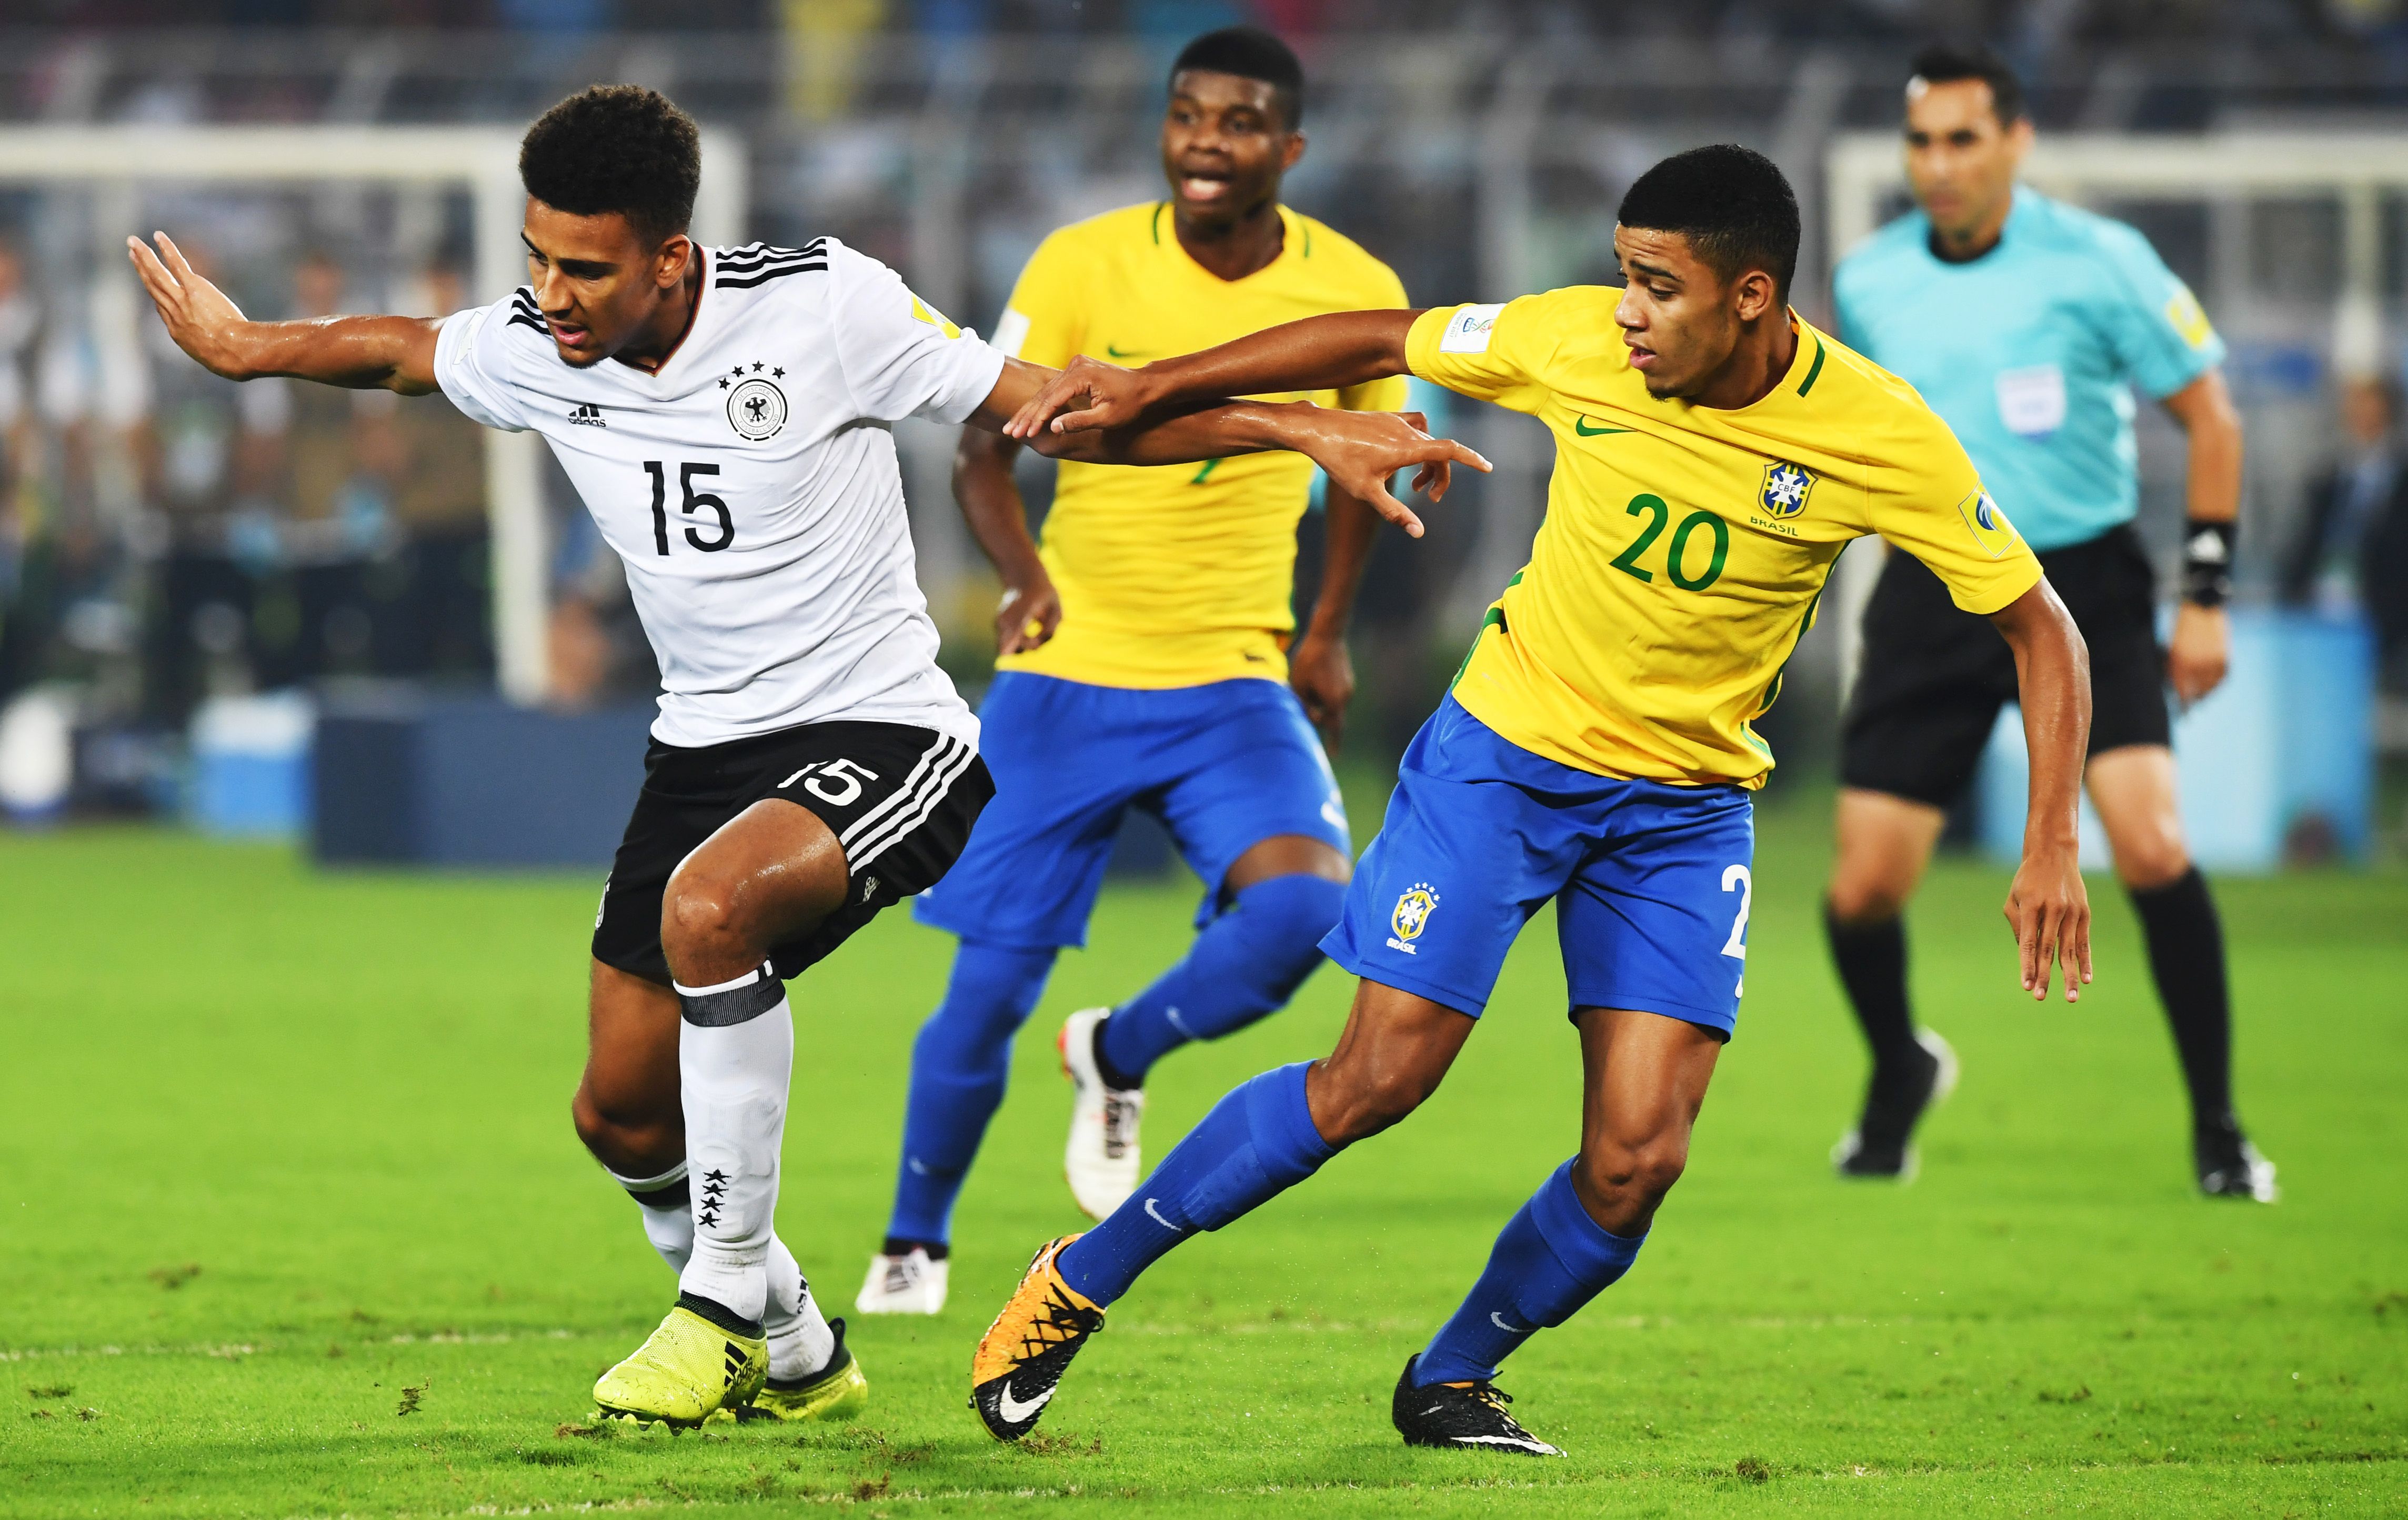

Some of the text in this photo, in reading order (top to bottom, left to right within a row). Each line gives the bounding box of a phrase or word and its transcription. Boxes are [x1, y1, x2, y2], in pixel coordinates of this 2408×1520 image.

[737, 387, 770, 402] DEUTSCHER
[568, 417, 606, 427] adidas
[739, 414, 779, 433] FUSSBALL-BUND
[1778, 484, 1795, 493] CBF
[644, 461, 735, 555] 15
[1750, 516, 1799, 537] BRASIL
[1609, 494, 1729, 592] 20
[777, 758, 879, 806] 15
[1386, 937, 1417, 955] BRASIL
